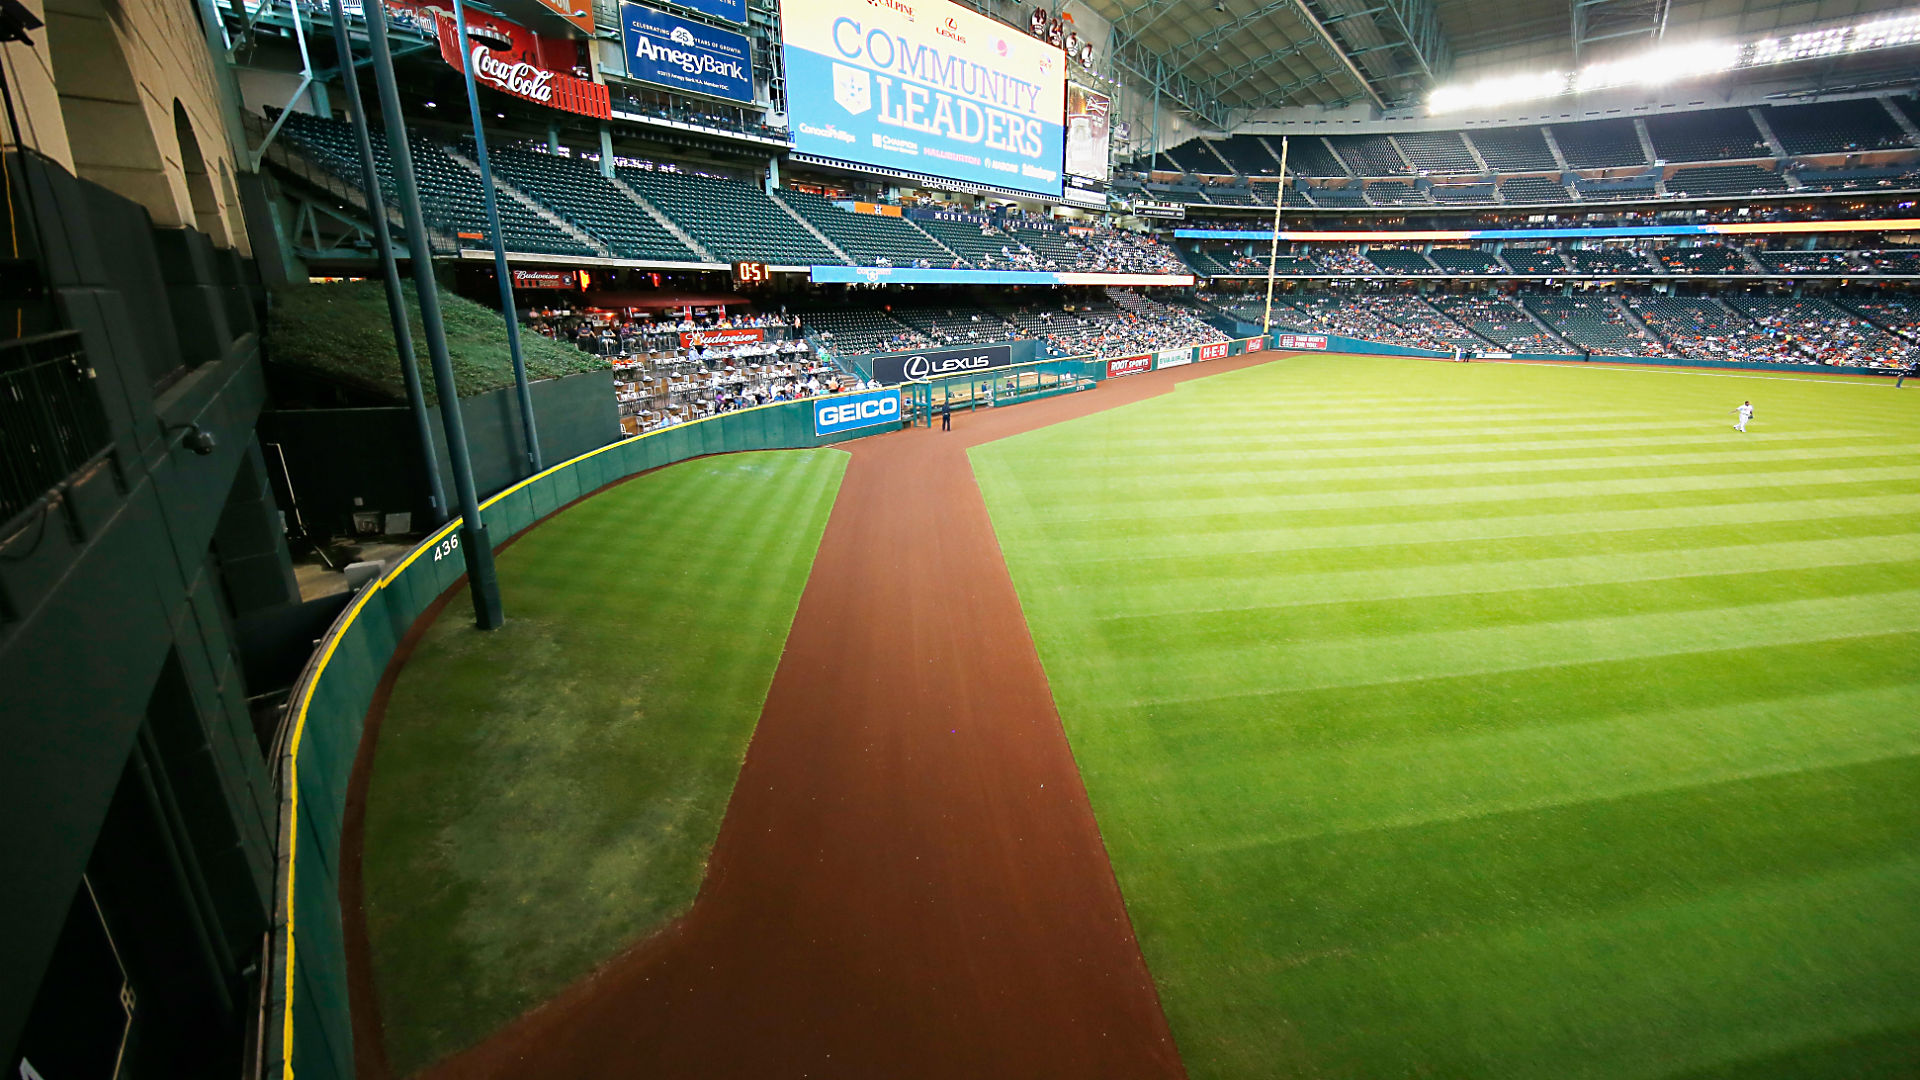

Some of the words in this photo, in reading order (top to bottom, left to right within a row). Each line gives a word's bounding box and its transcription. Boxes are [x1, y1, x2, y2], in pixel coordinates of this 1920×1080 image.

[1034, 6, 1047, 25] 49
[935, 27, 967, 44] LEXUS
[1052, 18, 1063, 37] 24
[632, 21, 670, 36] CELEBRATING
[675, 30, 689, 43] 25
[694, 38, 711, 47] YEARS
[719, 44, 742, 54] GROWTH
[471, 46, 553, 102] Coca-Cola
[832, 16, 1042, 114] COMMUNITY
[876, 74, 1043, 159] LEADERS
[921, 180, 979, 196] DAKTRONICS
[934, 211, 962, 222] MORE
[513, 270, 560, 281] Budweiser
[740, 262, 769, 281] 0:51
[685, 332, 758, 347] Budweiser
[931, 355, 990, 373] LEXUS
[1110, 359, 1129, 372] ROOT
[1128, 358, 1149, 369] SPORTS
[818, 397, 898, 427] GEICO
[433, 534, 459, 562] 436
